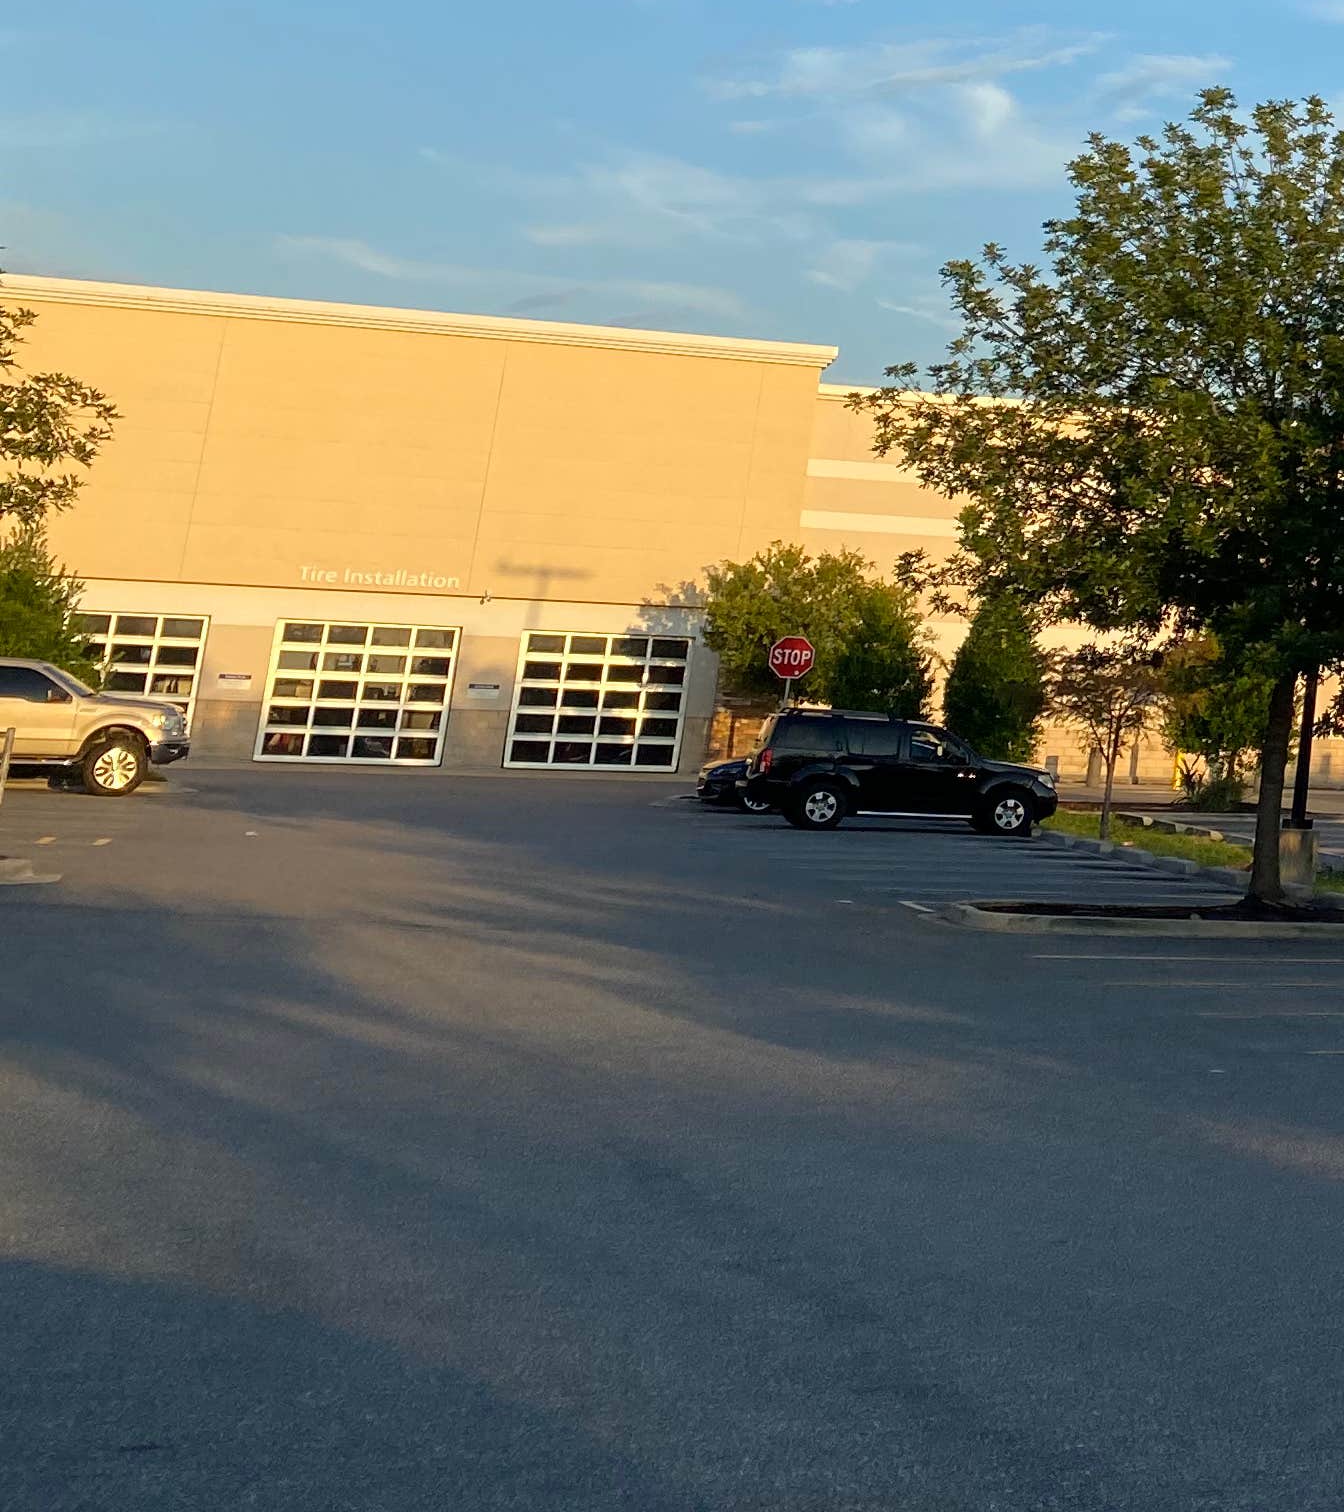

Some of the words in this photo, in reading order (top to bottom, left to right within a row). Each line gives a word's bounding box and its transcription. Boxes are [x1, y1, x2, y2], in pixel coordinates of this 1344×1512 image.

[299, 565, 338, 583] Tire
[343, 567, 461, 589] Installation
[772, 648, 811, 666] STOP
